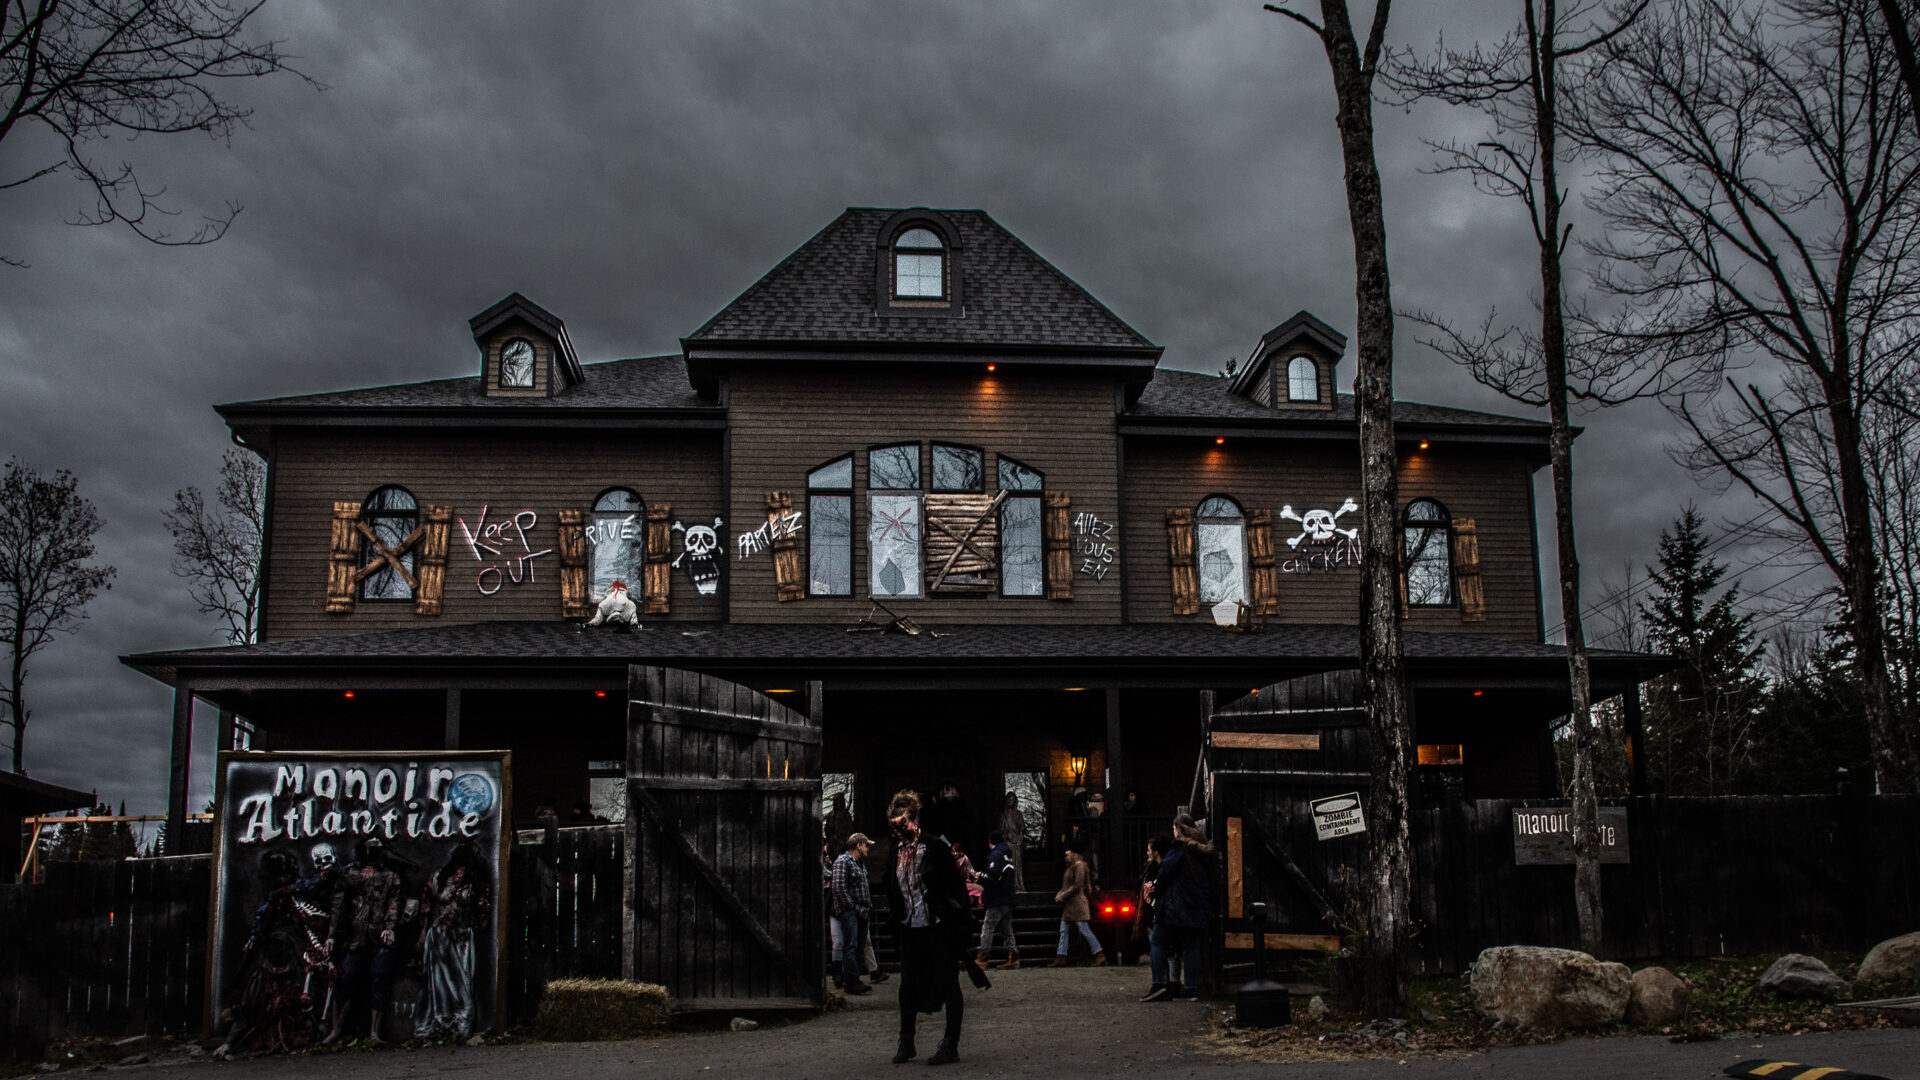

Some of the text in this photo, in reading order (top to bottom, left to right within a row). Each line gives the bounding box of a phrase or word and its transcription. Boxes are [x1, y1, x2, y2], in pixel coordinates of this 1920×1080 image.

[738, 512, 803, 560] PARTEZ
[477, 549, 552, 594] OUT
[1081, 558, 1108, 583] EN
[238, 794, 481, 844] Atlantide
[1319, 817, 1361, 831] CONTAINMENT
[1323, 810, 1354, 823] ZOMBIE
[1334, 827, 1349, 836] AREA
